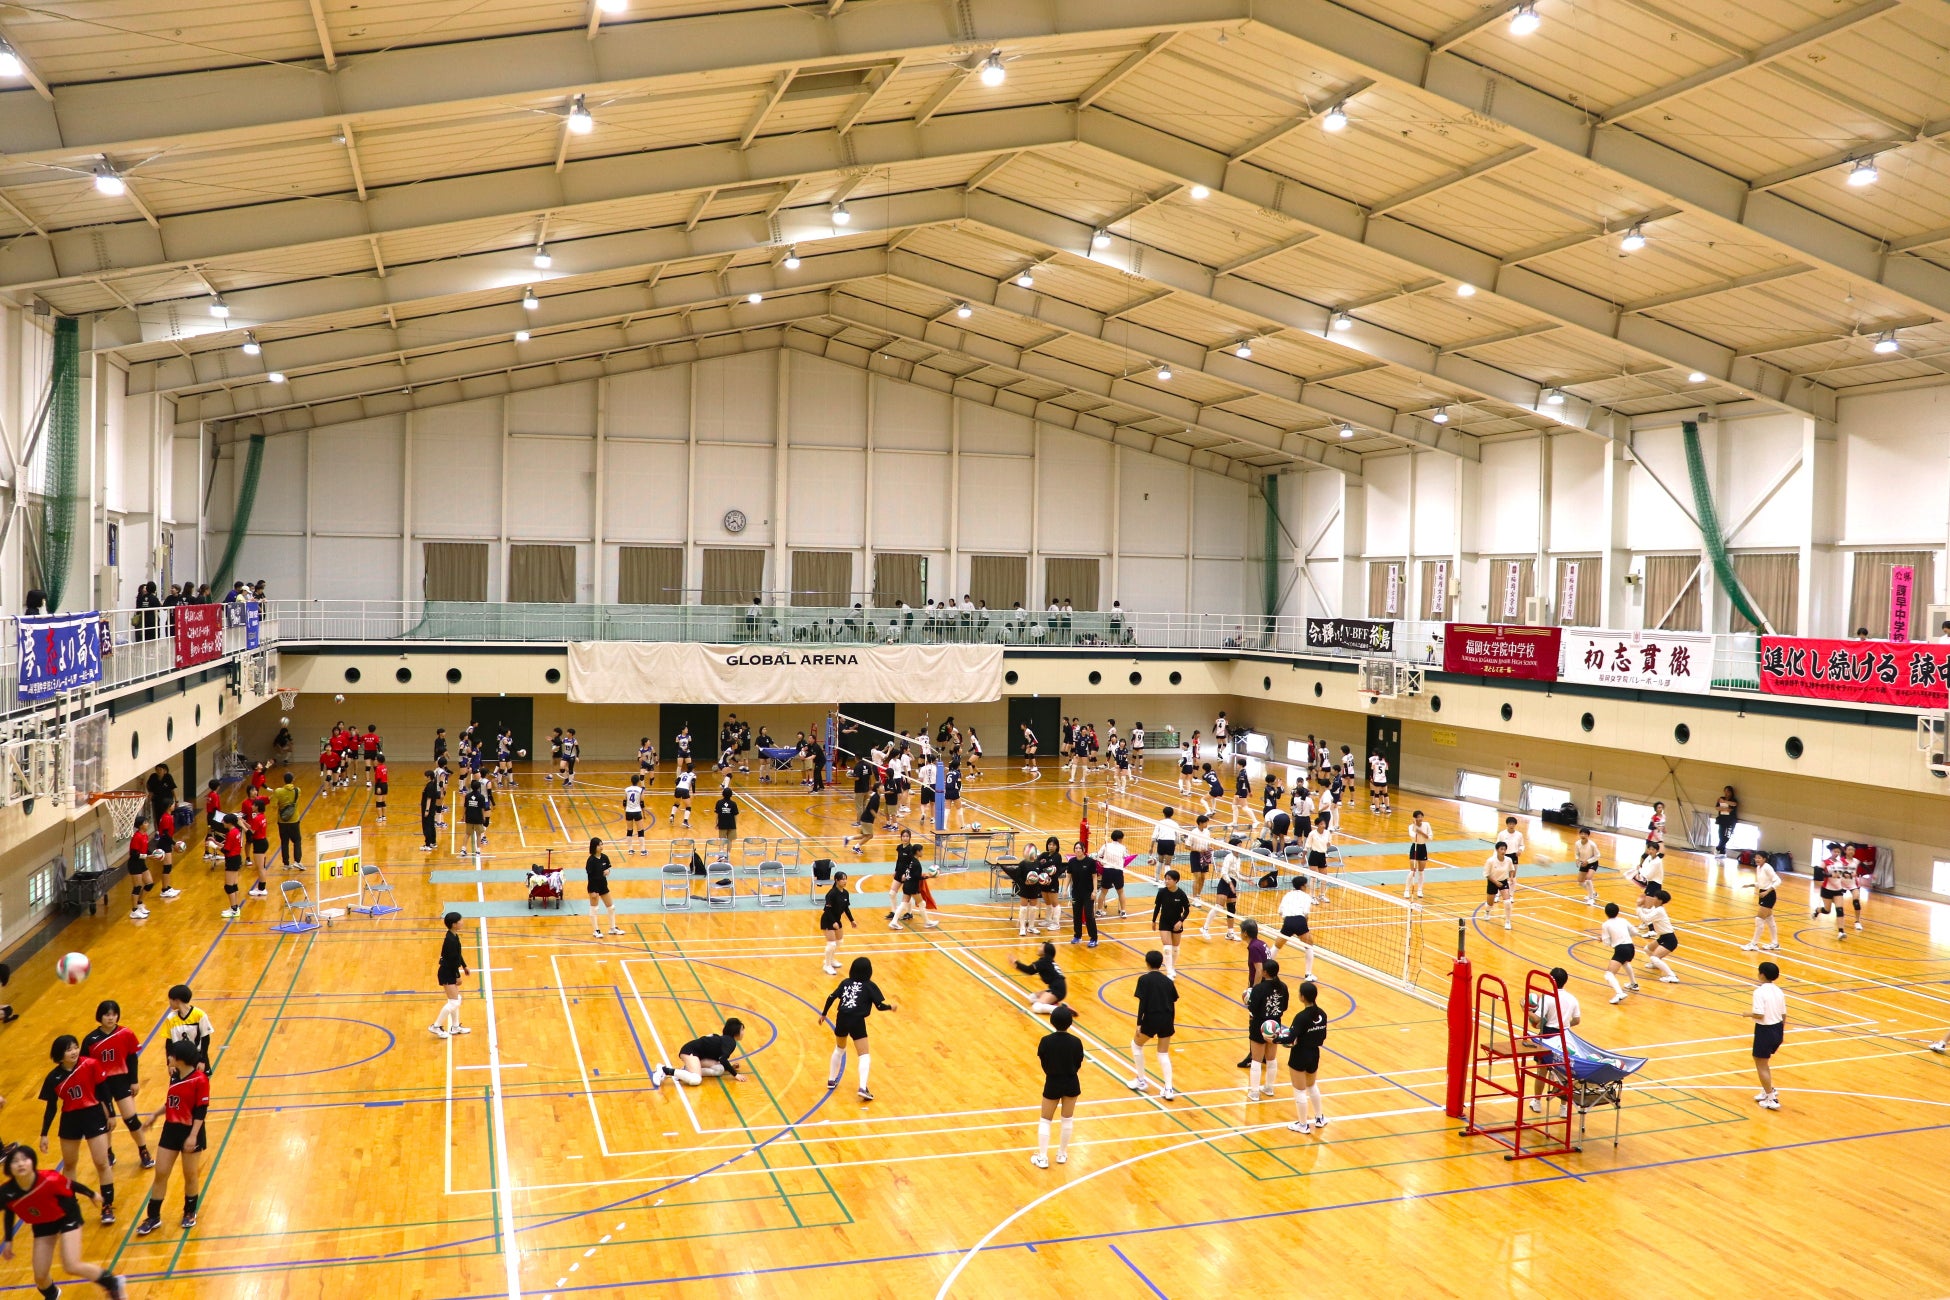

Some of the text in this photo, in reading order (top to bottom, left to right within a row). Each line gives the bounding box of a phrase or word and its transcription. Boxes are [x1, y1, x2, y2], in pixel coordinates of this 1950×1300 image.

[1345, 626, 1369, 640] V-BFF
[1369, 624, 1391, 650] 糸島
[1466, 639, 1535, 658] 福岡女学院中学校
[726, 654, 858, 666] GLOBAL ARENA
[1512, 658, 1523, 666] HIGH
[1584, 640, 1690, 677] 初志貫徹
[1763, 646, 1898, 685] 進化し続ける
[1598, 674, 1671, 687] 福岡女学院バレーボール部
[1378, 766, 1383, 775] 5
[946, 774, 953, 784] 6
[1208, 774, 1217, 783] 3
[629, 793, 636, 803] 4
[101, 1049, 115, 1062] 11
[67, 1085, 83, 1100] 10
[168, 1095, 181, 1110] 12
